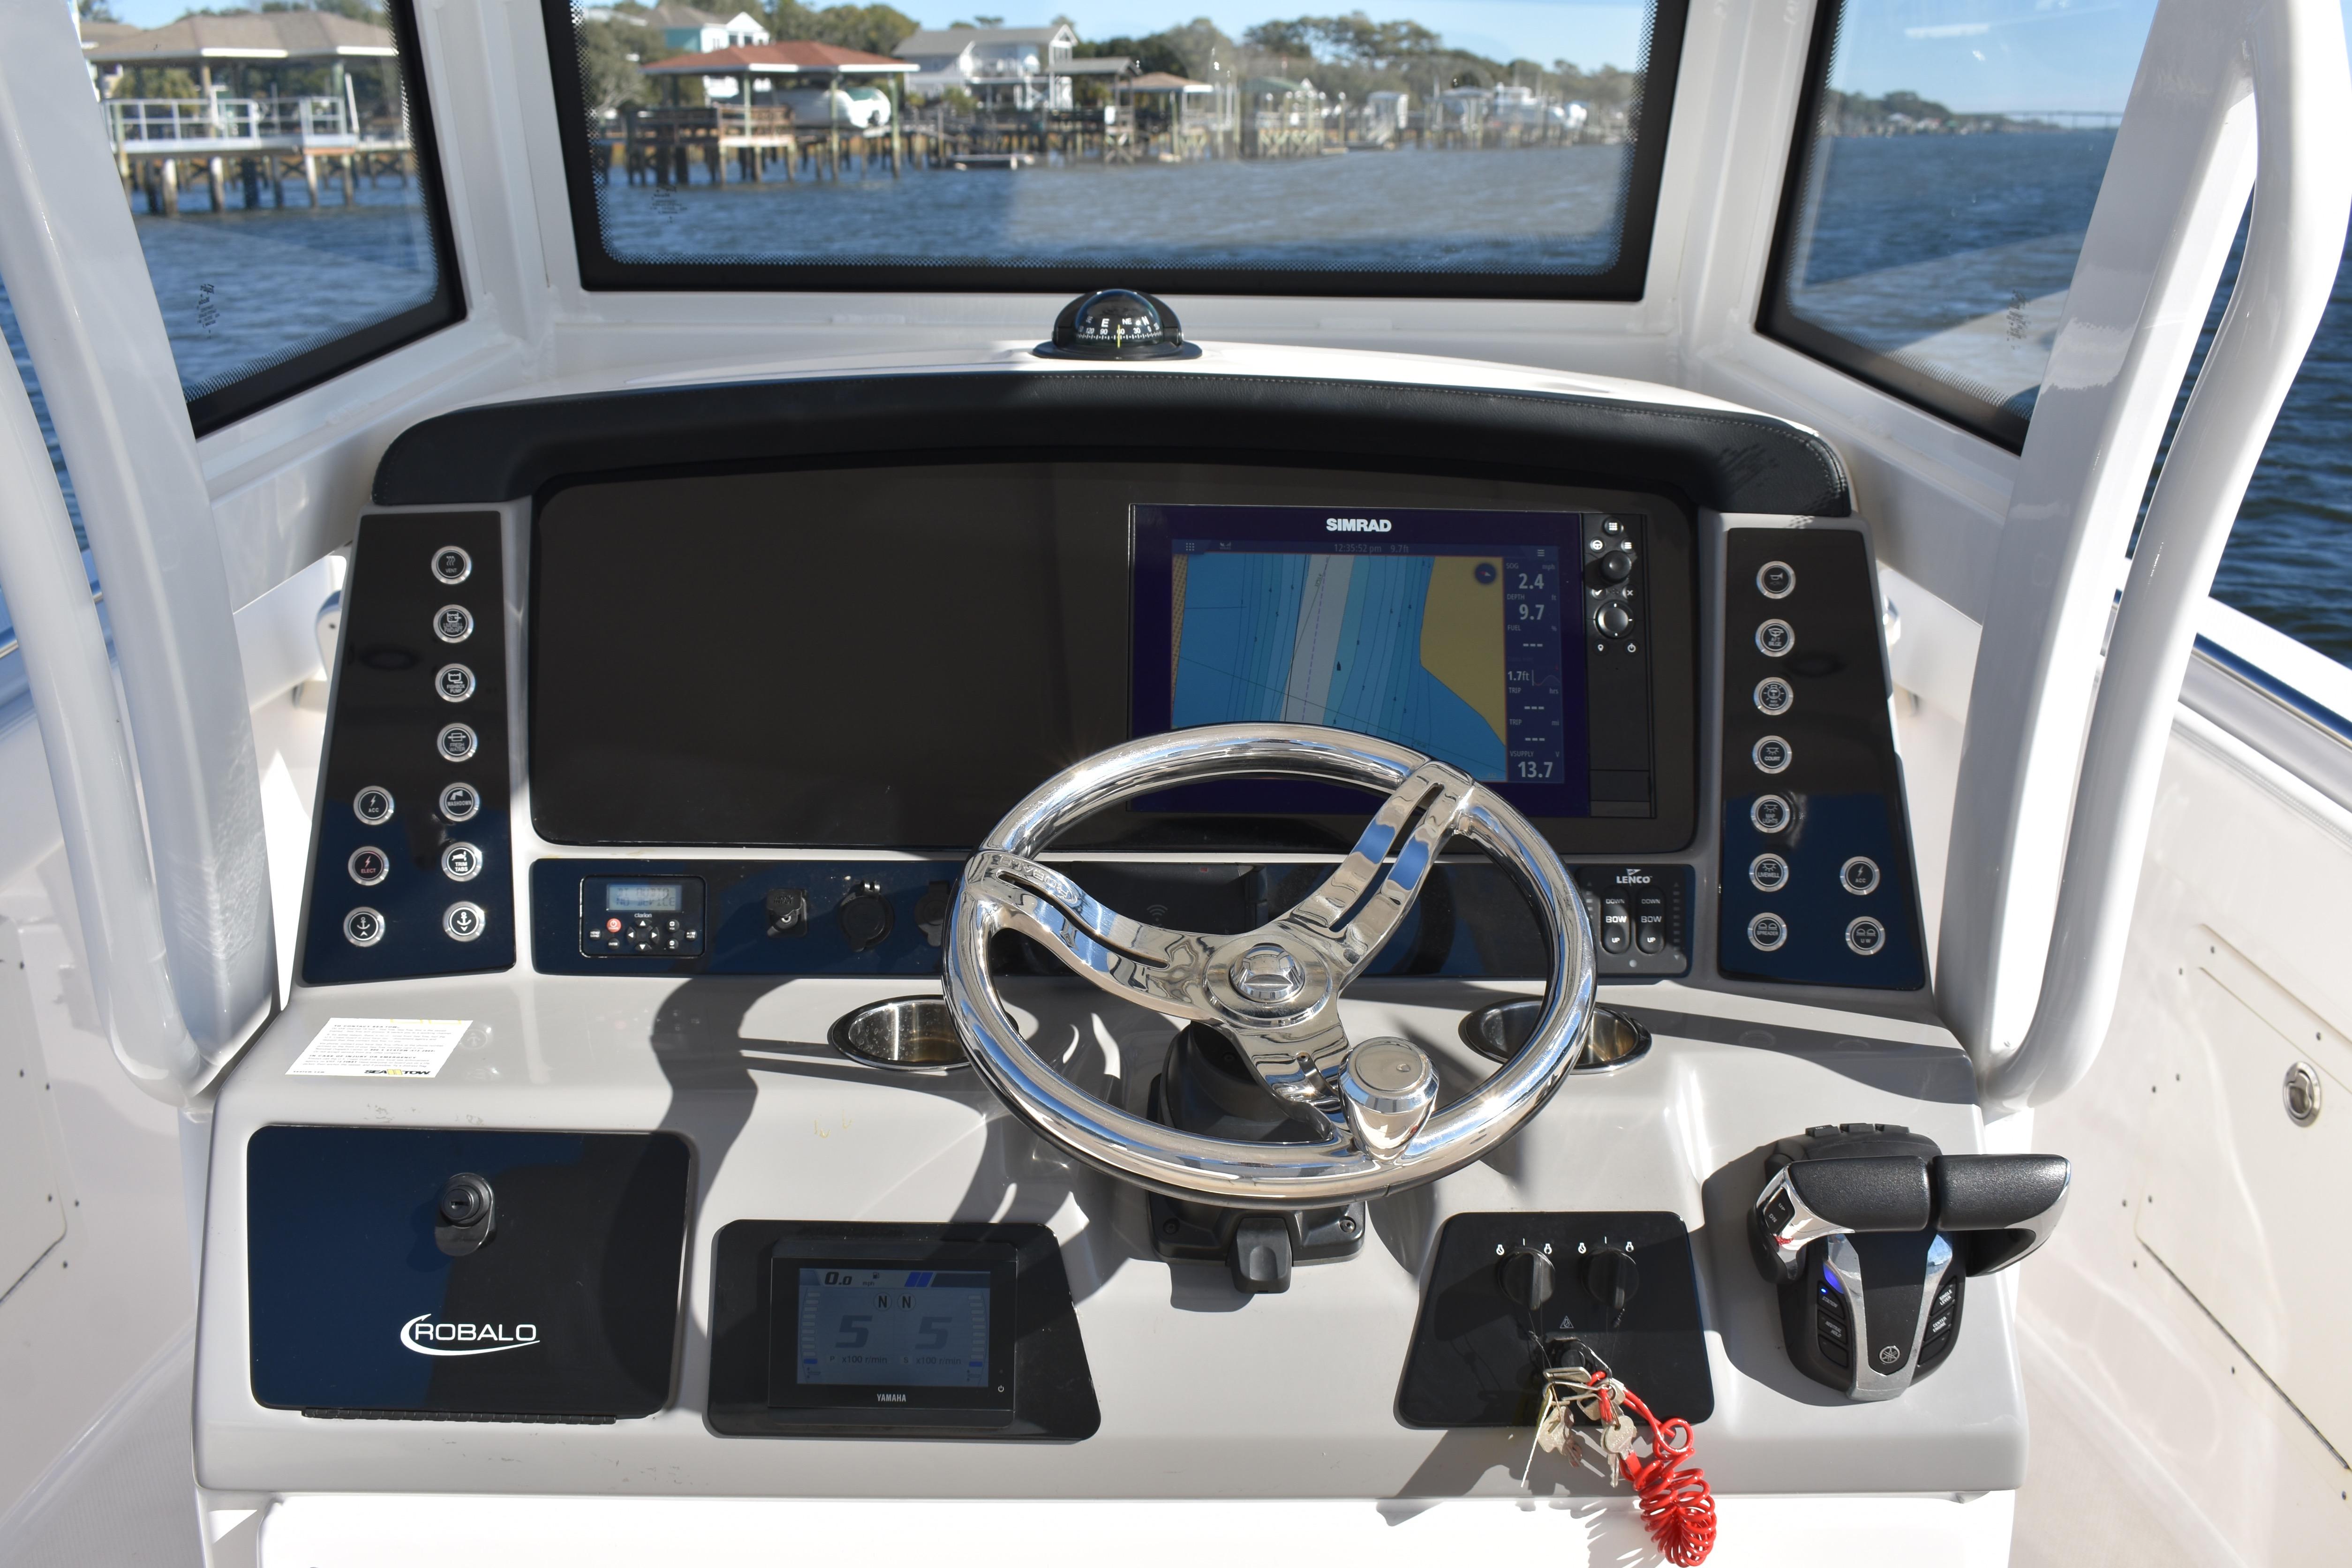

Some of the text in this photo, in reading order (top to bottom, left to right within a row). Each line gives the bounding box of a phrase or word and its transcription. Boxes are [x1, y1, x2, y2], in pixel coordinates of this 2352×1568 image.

[1101, 318, 1109, 327] E
[1141, 316, 1149, 325] N
[1326, 518, 1392, 532] SIMRAD
[1334, 544, 1367, 552] 12:35:52
[1369, 546, 1381, 555] pm
[1519, 573, 1544, 589] 2.4
[1519, 604, 1545, 620] 9.7
[1508, 671, 1530, 681] 1.7ft
[1518, 761, 1553, 778] 13.7
[1769, 1213, 1778, 1223] DN
[824, 1271, 852, 1286] 0.0
[1939, 1289, 1952, 1301] SINGLE
[1939, 1295, 1952, 1305] LEVER
[878, 1295, 887, 1309] N
[902, 1296, 911, 1309] N
[1822, 1296, 1838, 1308] STATION
[1825, 1321, 1842, 1333] NEUTRAL
[1932, 1316, 1947, 1328] CENTER
[1932, 1321, 1946, 1333] ENGINE
[415, 1324, 536, 1341] ROBALO
[835, 1315, 873, 1349] 5
[915, 1316, 952, 1350] 5
[1831, 1329, 1842, 1338] HOLD
[841, 1356, 862, 1364] x100
[865, 1356, 887, 1364] r/min
[916, 1357, 936, 1365] x100
[938, 1357, 961, 1365] r/min
[876, 1394, 906, 1402] YAMAHA
